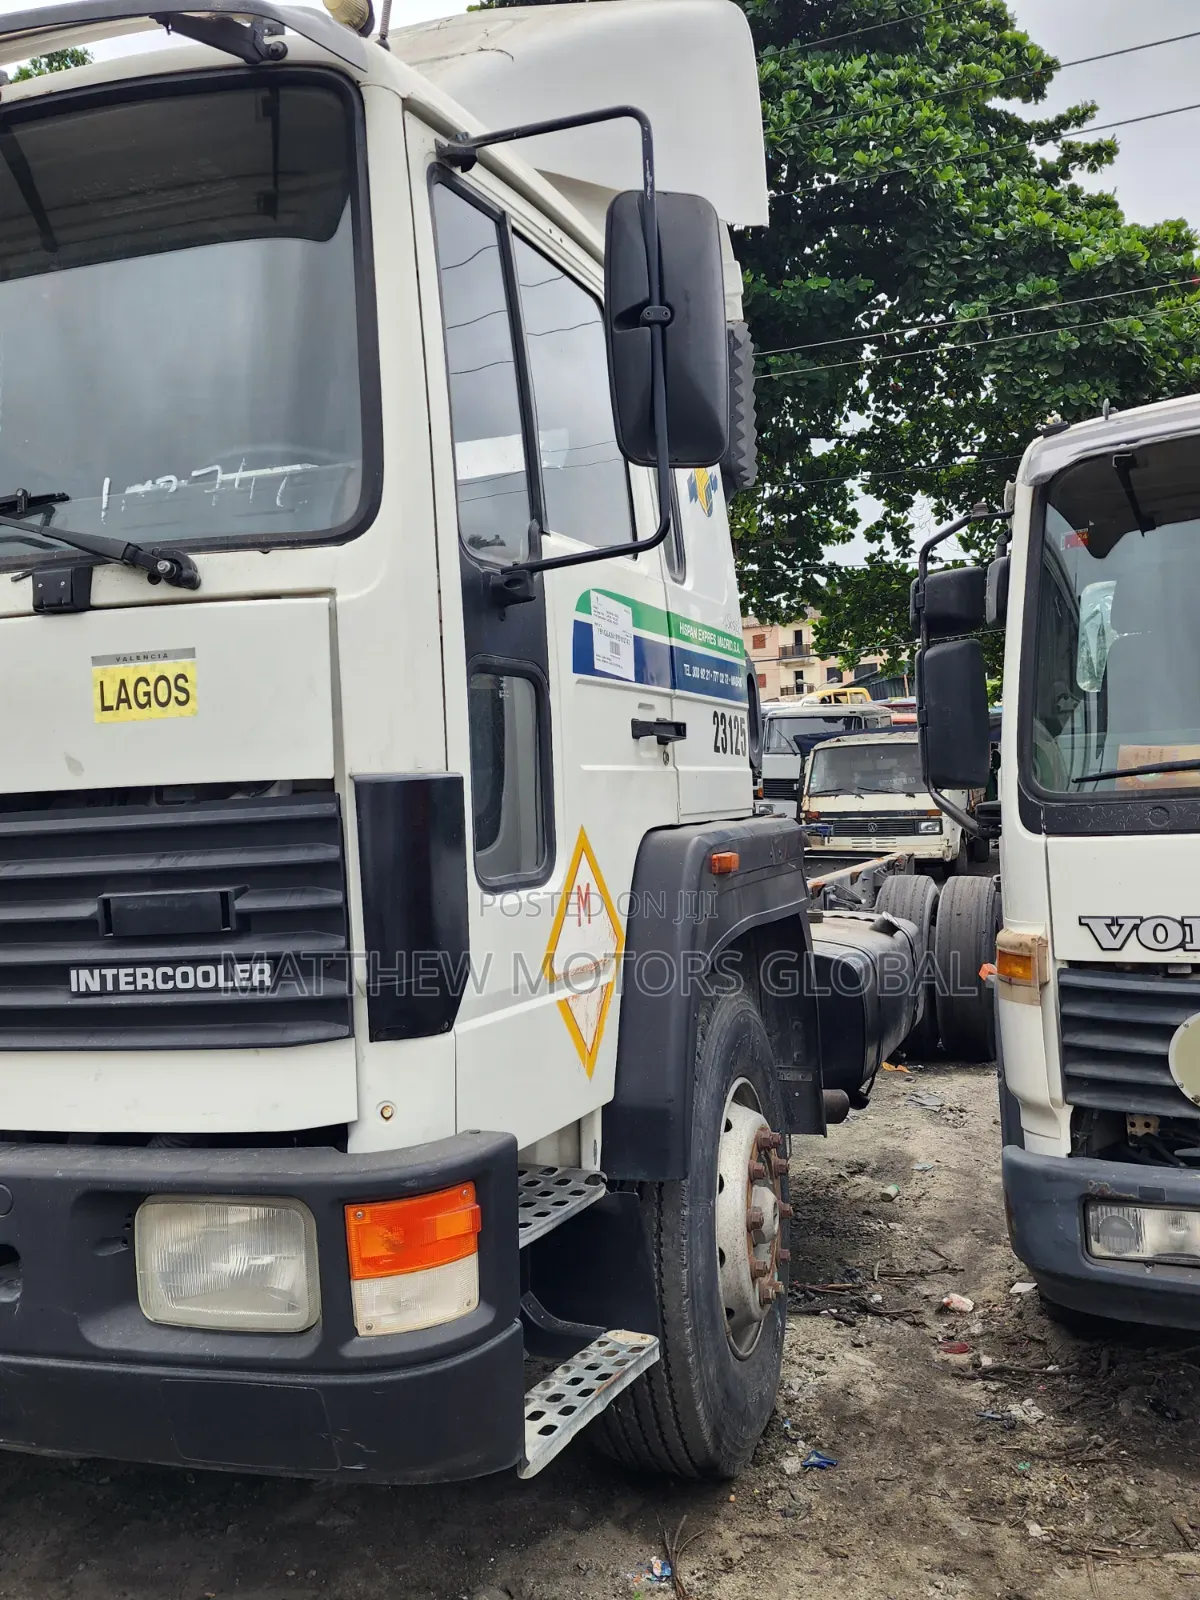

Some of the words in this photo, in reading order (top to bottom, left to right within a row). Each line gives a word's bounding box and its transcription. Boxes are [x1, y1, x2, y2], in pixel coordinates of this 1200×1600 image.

[116, 653, 168, 662] VALENCIA
[99, 673, 190, 712] LAGOS
[712, 710, 747, 757] 23125
[70, 963, 272, 992] INTERCOOLER
